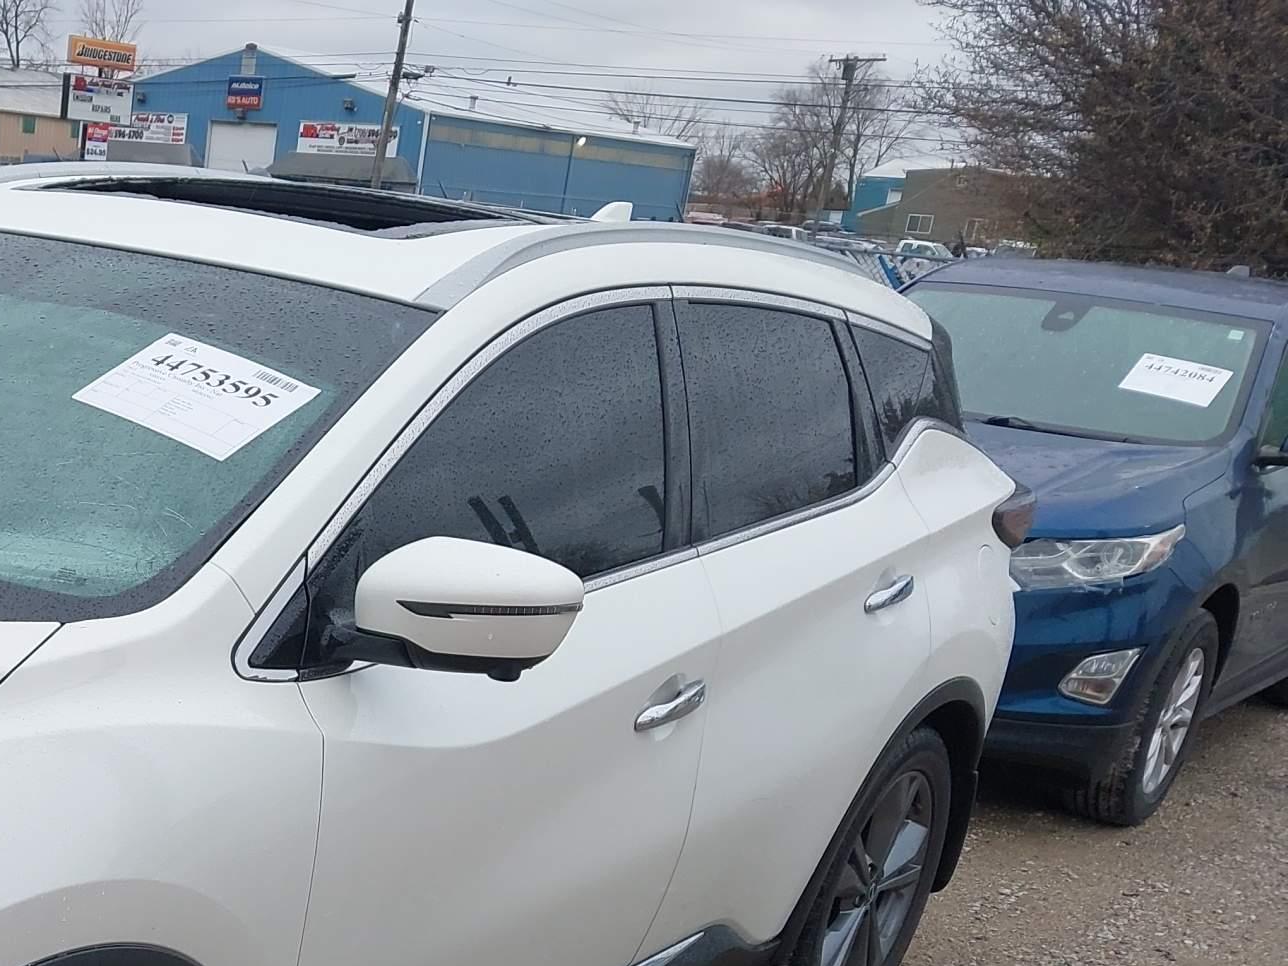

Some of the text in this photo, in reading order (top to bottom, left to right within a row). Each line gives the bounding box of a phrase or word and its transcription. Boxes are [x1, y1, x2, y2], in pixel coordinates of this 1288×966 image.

[77, 44, 132, 64] BRIDGESTONE
[151, 354, 279, 408] 44753595
[1144, 363, 1216, 383] 44742084
